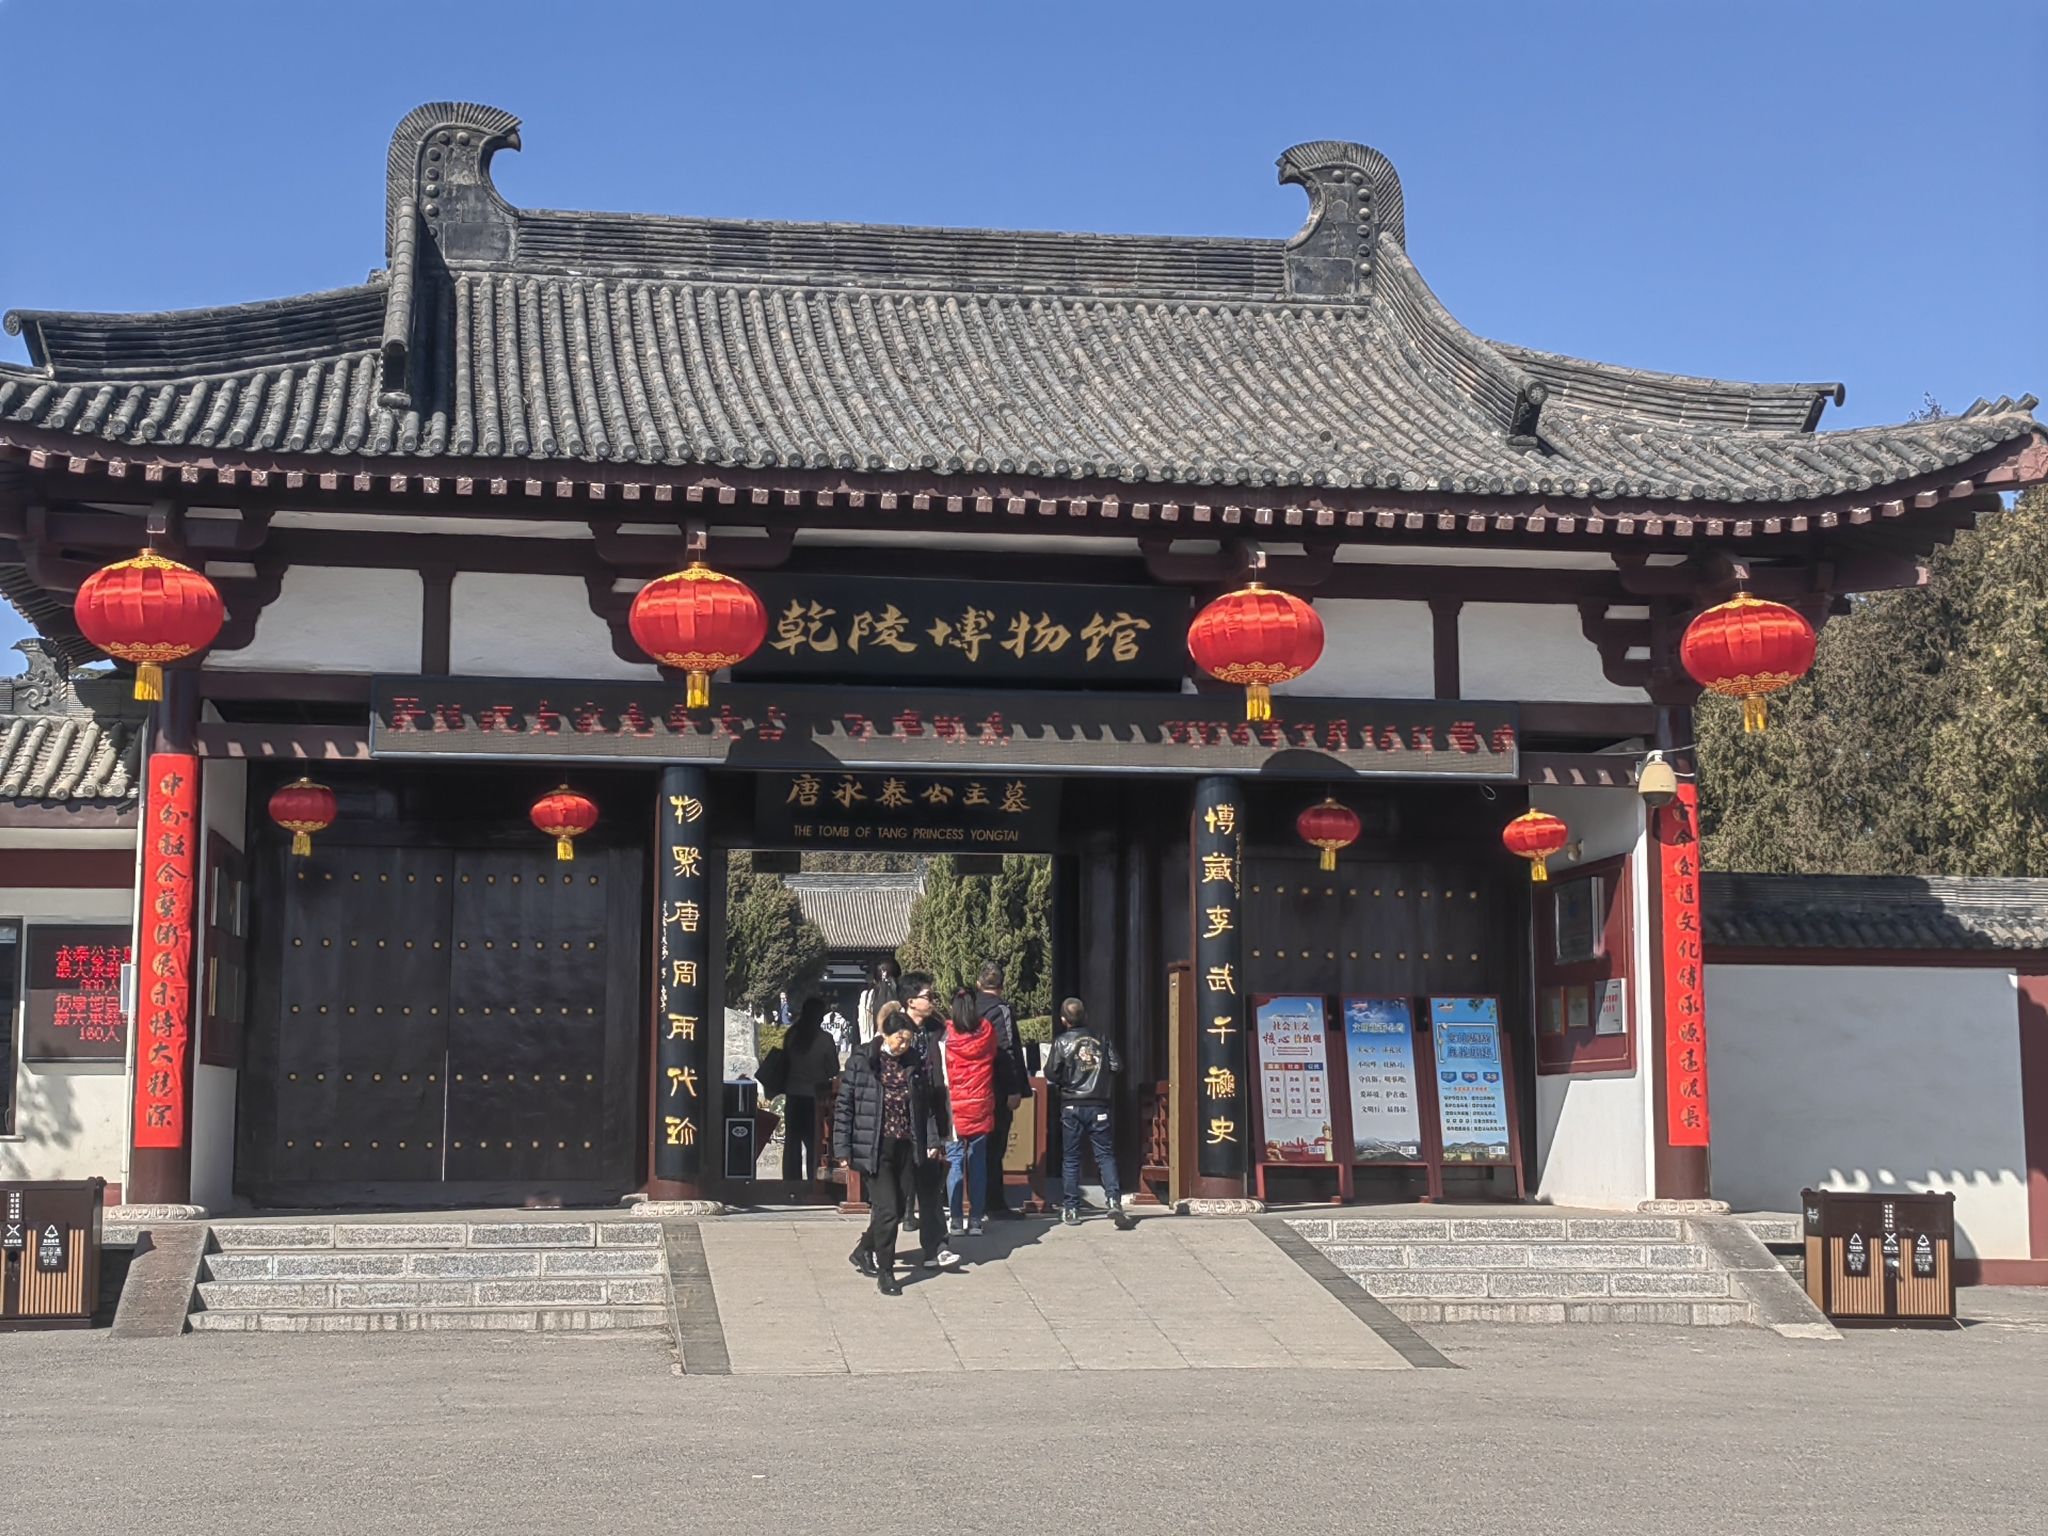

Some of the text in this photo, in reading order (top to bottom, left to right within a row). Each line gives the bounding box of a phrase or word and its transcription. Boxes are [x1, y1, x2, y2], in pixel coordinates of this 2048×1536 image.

[768, 599, 1151, 662] 乾陵博物馆
[786, 774, 1031, 813] 唐永泰公主墓
[794, 825, 1019, 842] THE TOMB OF TANG PRINCESS YONGTAI
